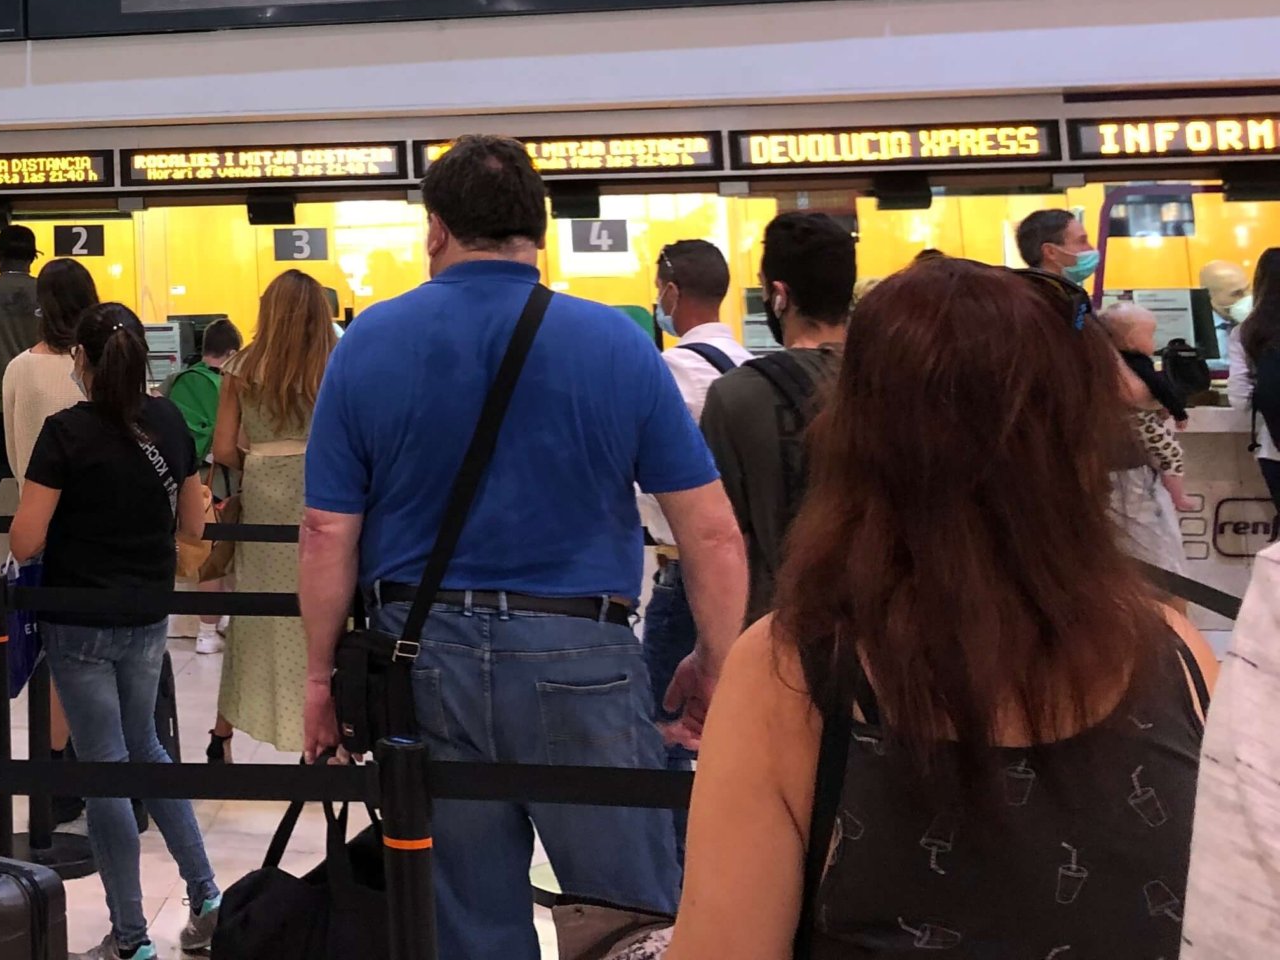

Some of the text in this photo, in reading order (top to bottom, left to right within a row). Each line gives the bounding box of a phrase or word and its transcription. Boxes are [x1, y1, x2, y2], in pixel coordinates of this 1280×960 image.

[919, 126, 1040, 159] XPRESS
[1099, 118, 1275, 155] INFORM
[12, 156, 91, 172] DISTANCIA
[134, 152, 219, 169] RODALIES
[224, 152, 235, 166] I
[238, 149, 298, 166] MITJA
[22, 170, 46, 184] las
[88, 169, 98, 182] h
[71, 226, 89, 255] 2
[292, 229, 312, 259] 3
[589, 221, 613, 251] 4
